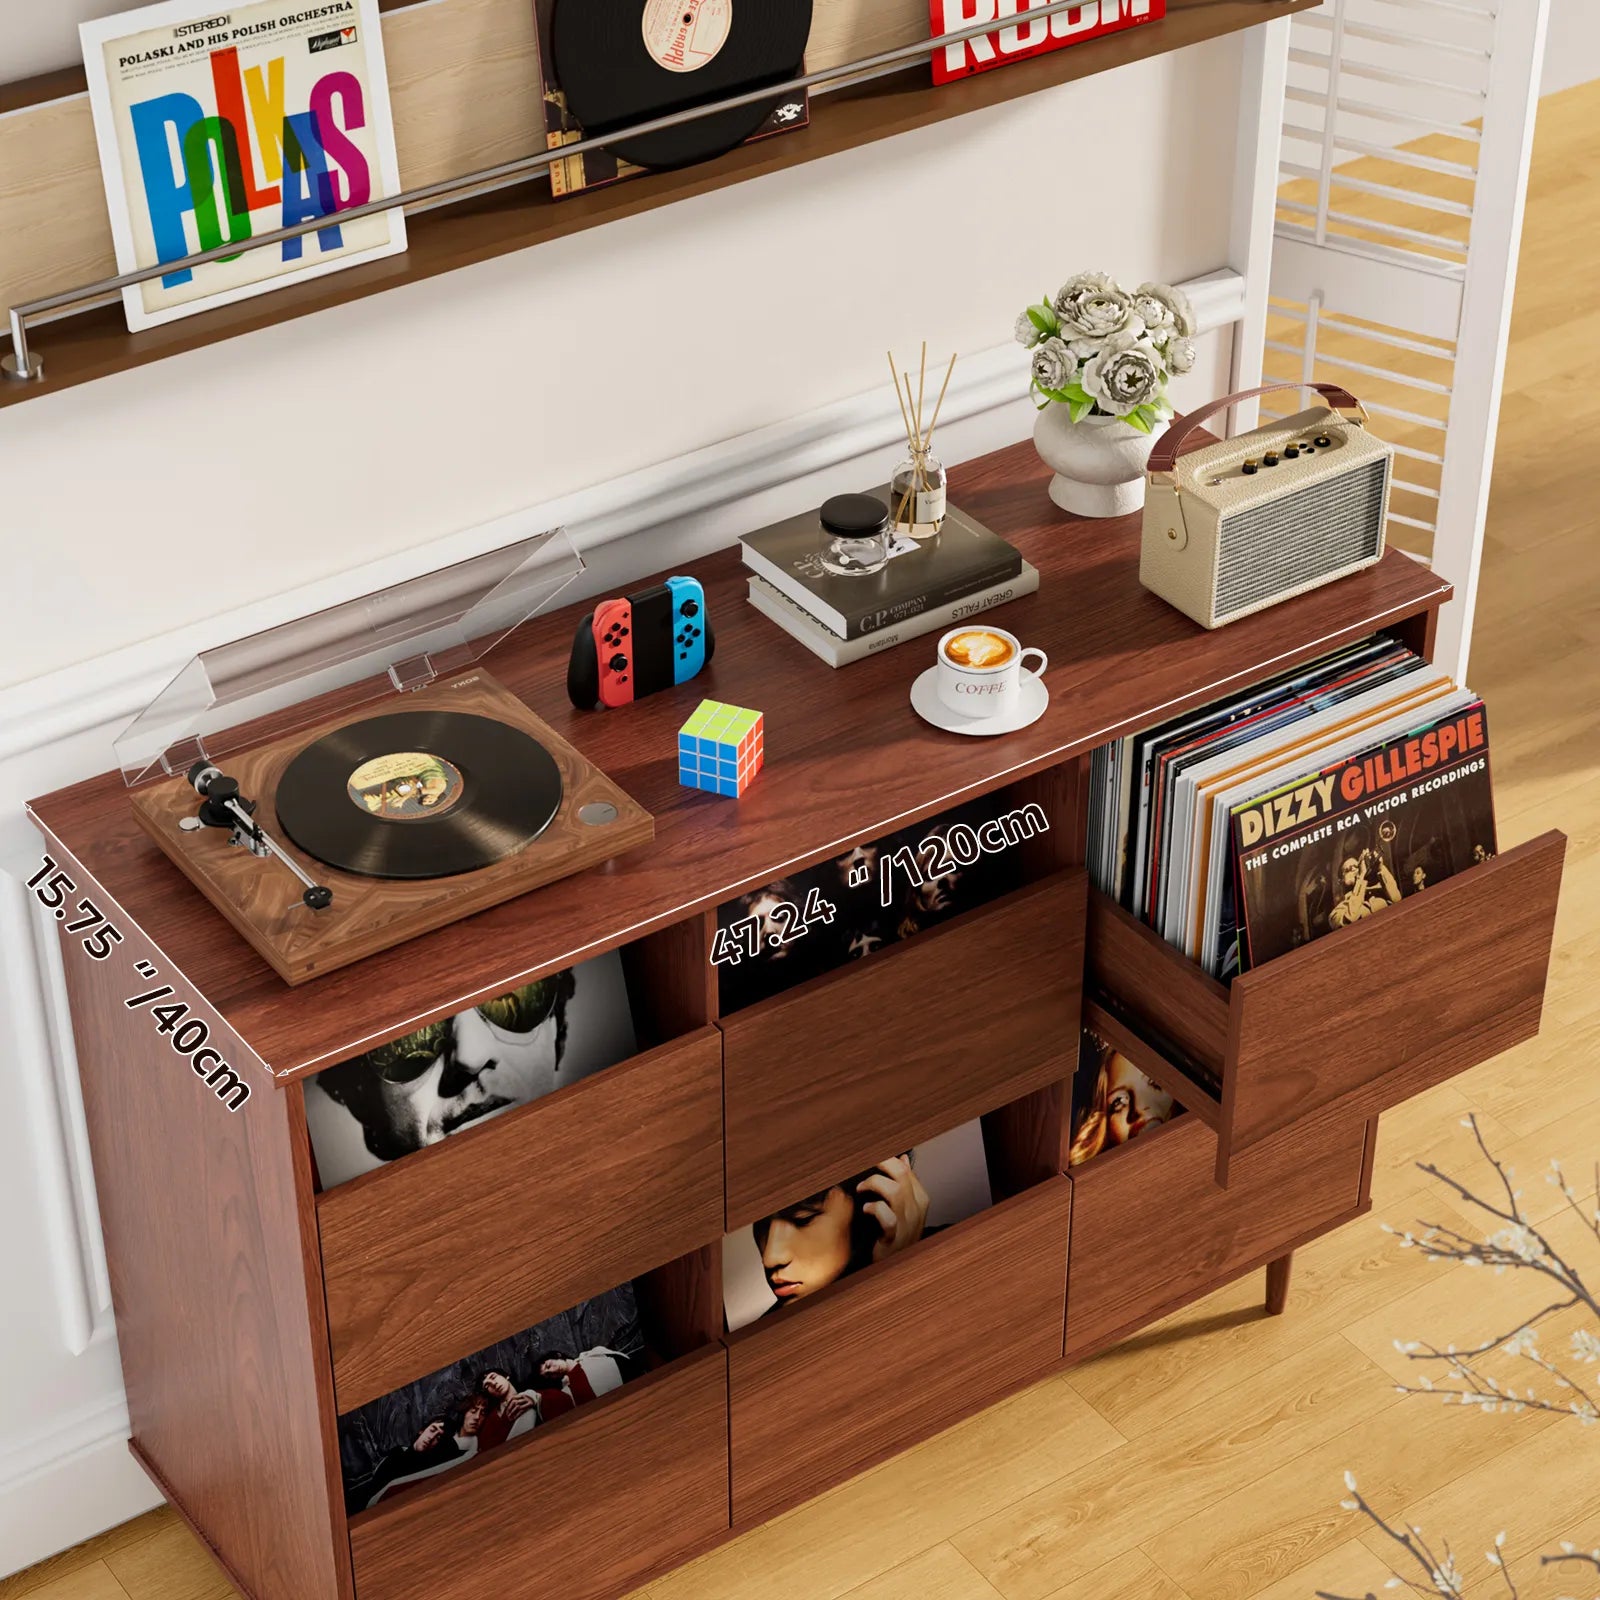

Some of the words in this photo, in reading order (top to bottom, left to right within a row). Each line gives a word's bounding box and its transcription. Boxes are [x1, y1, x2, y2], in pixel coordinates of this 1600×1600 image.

[119, 45, 174, 67] POLASKI
[178, 38, 204, 54] AND
[208, 32, 229, 46] HIS
[232, 20, 276, 39] POLISH
[279, 1, 353, 27] ORCHESTRA
[177, 16, 228, 38] STEREO
[661, 27, 688, 67] GRAPH
[944, 0, 1150, 73] RO
[129, 46, 371, 289] POLKAS
[951, 601, 980, 620] FALLS
[982, 588, 1013, 608] GREAT
[860, 611, 887, 632] C.P.
[869, 634, 898, 650] Montana
[1240, 774, 1336, 848] DIZZY
[1340, 712, 1484, 801] GILLESPIE
[1245, 853, 1268, 871] THE
[1272, 825, 1333, 859] COMPLETE
[1337, 813, 1361, 831] RCA
[1364, 793, 1408, 819] VICTOR
[1411, 758, 1486, 799] RECORDINGS
